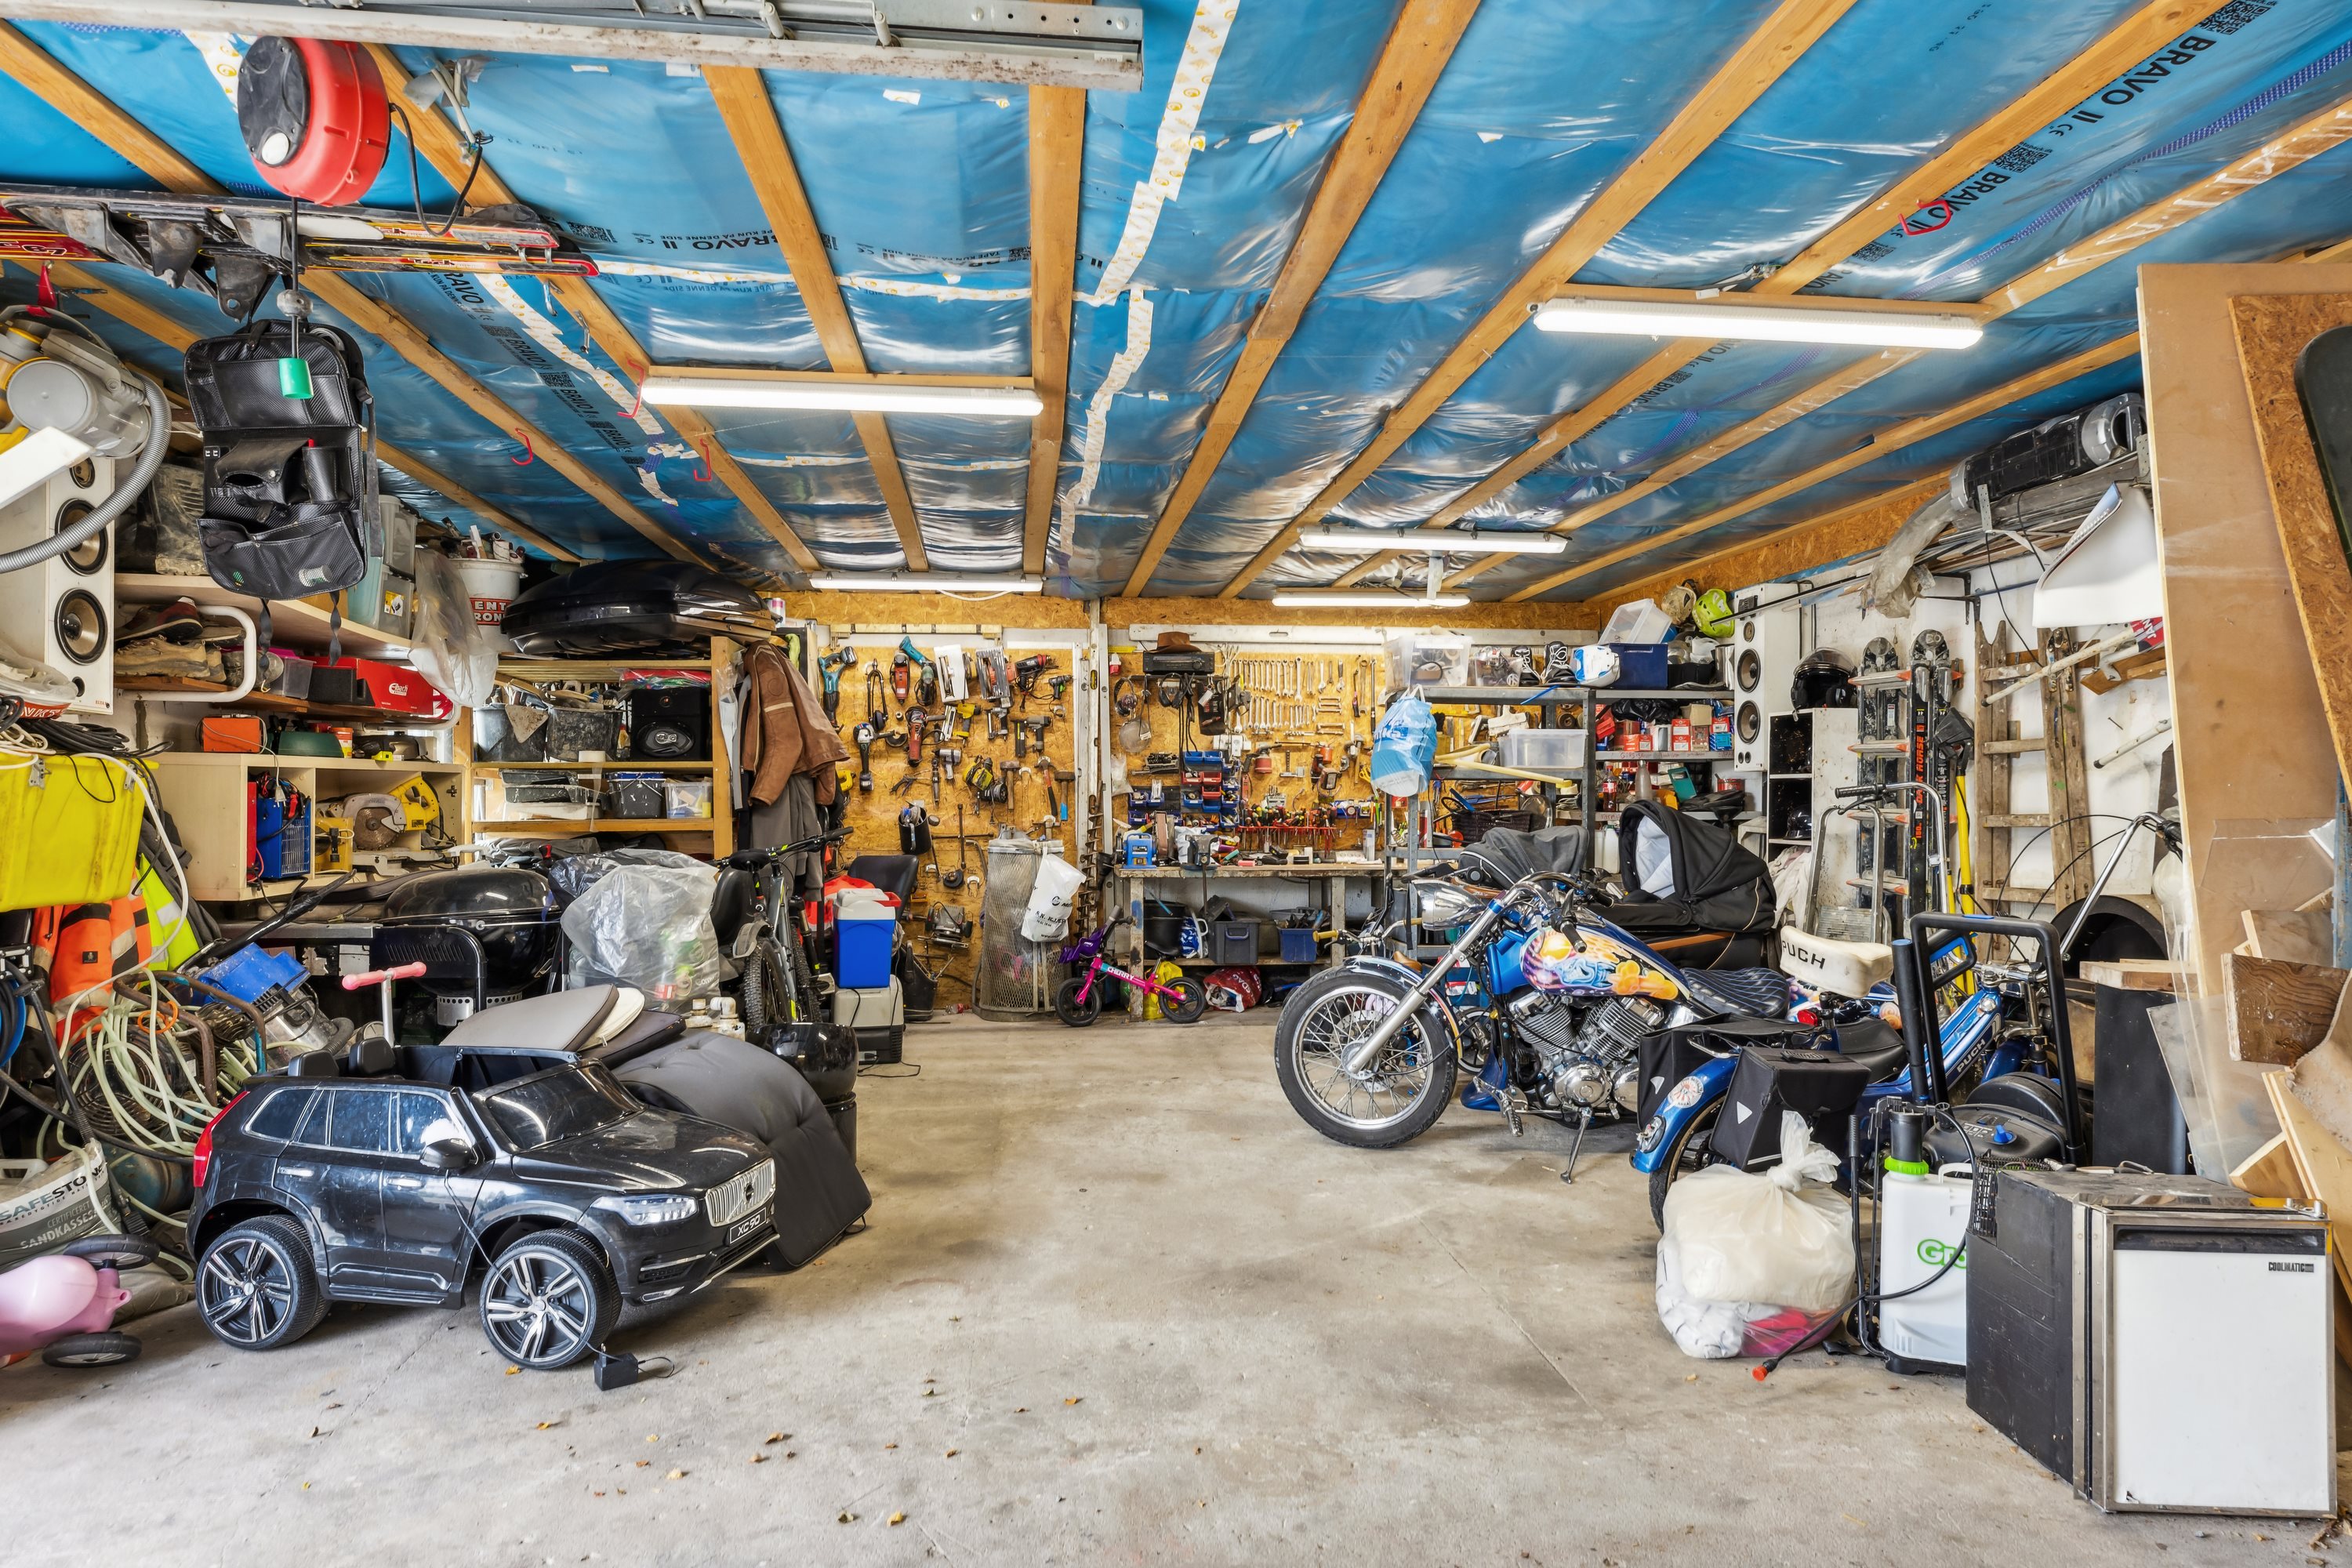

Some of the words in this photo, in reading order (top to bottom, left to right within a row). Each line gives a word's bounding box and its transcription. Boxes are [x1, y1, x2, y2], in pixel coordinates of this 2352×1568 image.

[2101, 35, 2217, 105] BRAVO
[474, 601, 506, 611] ENT
[1915, 775, 1925, 805] DAK
[1781, 940, 1826, 970] PUCH
[1107, 966, 1134, 981] CHERRY
[1956, 1038, 1986, 1073] PUCH
[47, 1200, 90, 1229] CERTIFICERET
[2268, 1261, 2305, 1272] COOLMATIC
